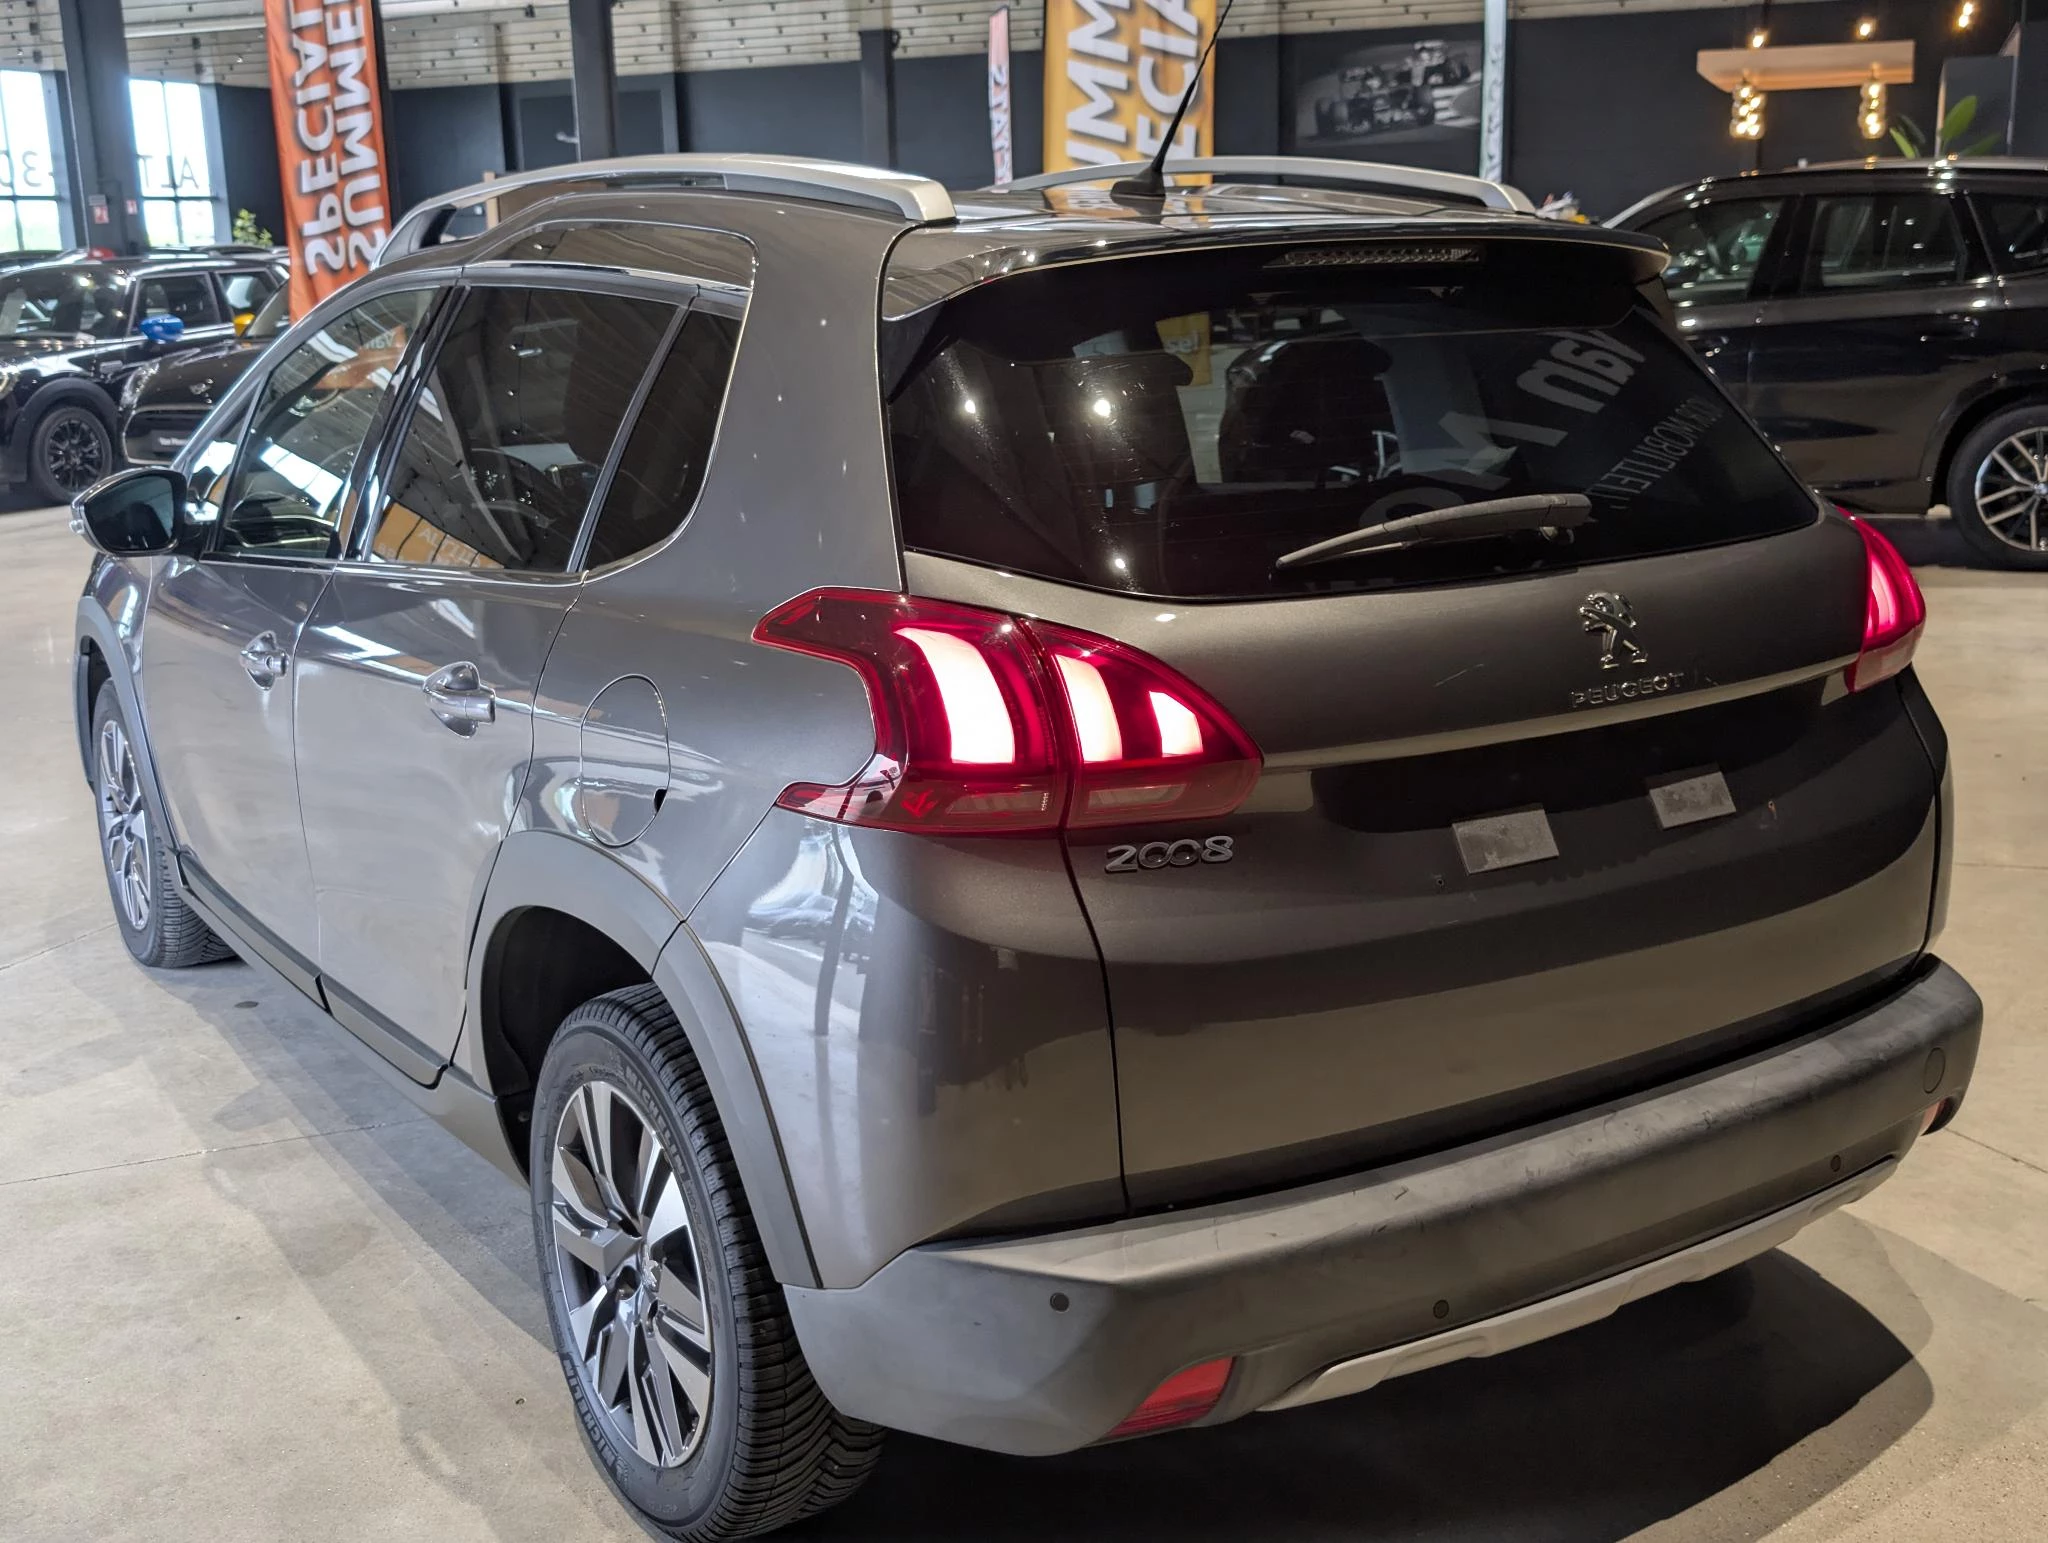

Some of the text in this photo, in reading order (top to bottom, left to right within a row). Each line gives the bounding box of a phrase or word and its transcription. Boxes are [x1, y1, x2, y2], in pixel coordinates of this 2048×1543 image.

[1571, 672, 1685, 708] PEUGEOT
[1105, 835, 1234, 873] 2008
[625, 1065, 686, 1175] MICHELIN
[562, 1359, 616, 1467] MICHELIN
